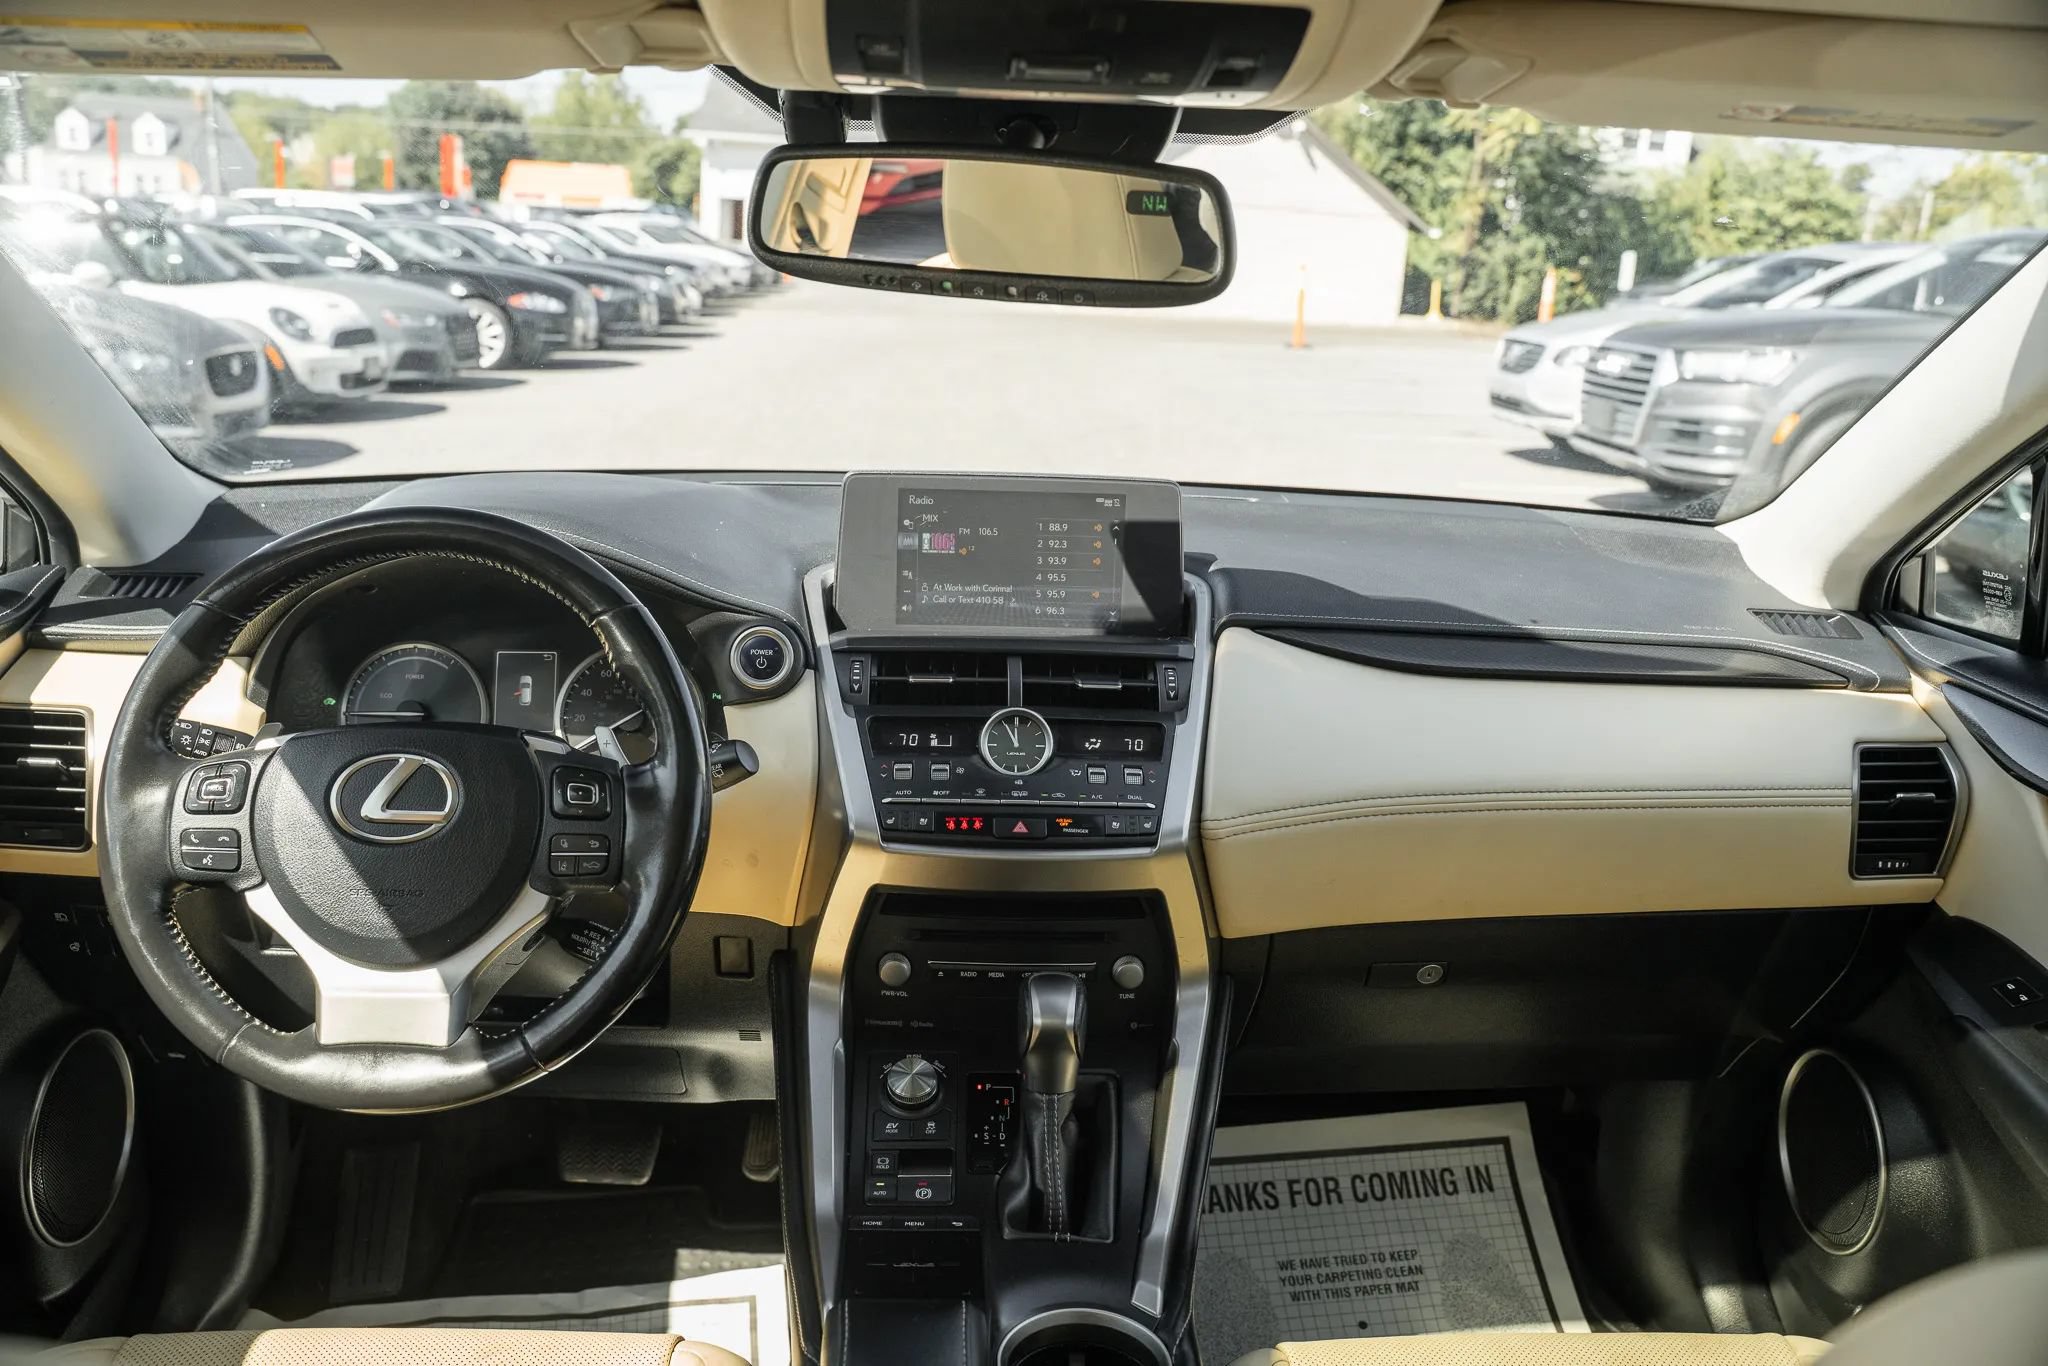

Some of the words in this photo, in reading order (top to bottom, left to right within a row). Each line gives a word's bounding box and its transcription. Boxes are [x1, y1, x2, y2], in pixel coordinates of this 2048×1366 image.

[1142, 195, 1168, 211] NW
[908, 494, 934, 505] Radio
[922, 514, 939, 523] MIX
[958, 528, 971, 536] FM
[978, 527, 998, 536] 106.5
[1038, 523, 1043, 531] 1
[1048, 523, 1068, 532] 88.9
[1037, 540, 1043, 548] 2
[1048, 540, 1067, 548] 92.3
[1037, 556, 1043, 565] 3
[1047, 556, 1067, 565] 93.9
[1035, 573, 1042, 581] 4
[1047, 573, 1066, 582] 95.5
[933, 583, 942, 592] At
[944, 583, 963, 592] Work
[965, 583, 981, 592] with
[1036, 590, 1041, 598] 5
[1046, 590, 1066, 599] 95.9
[932, 595, 947, 604] Call
[958, 596, 974, 604] Text
[1035, 606, 1041, 615] 6
[1046, 606, 1065, 615] 96.3
[750, 648, 773, 656] POWER
[600, 669, 612, 678] 60
[581, 688, 592, 697] 40
[574, 713, 586, 722] 20
[899, 733, 919, 746] 70
[1124, 738, 1144, 751] 70
[206, 784, 224, 792] MODE
[985, 1083, 991, 1091] P
[1004, 1098, 1010, 1106] R
[999, 1114, 1006, 1122] N
[983, 1132, 990, 1140] S
[999, 1132, 1006, 1140] D
[1201, 1180, 1280, 1214] ANKS
[1287, 1176, 1343, 1208] FOR
[1350, 1167, 1460, 1203] COMING
[1465, 1164, 1494, 1194] IN
[1278, 1259, 1297, 1271] WE
[1299, 1255, 1330, 1270] HAVE
[1332, 1253, 1367, 1267] TRIED
[1370, 1252, 1386, 1263] TO
[1388, 1249, 1418, 1262] KEEP
[1279, 1274, 1314, 1287] YOUR
[1316, 1268, 1382, 1285] CARPETING
[1385, 1264, 1423, 1279] CLEAN
[1289, 1289, 1321, 1302] WITH
[1323, 1286, 1351, 1300] THIS
[1354, 1283, 1393, 1297] PAPER
[1395, 1280, 1420, 1293] MAT
